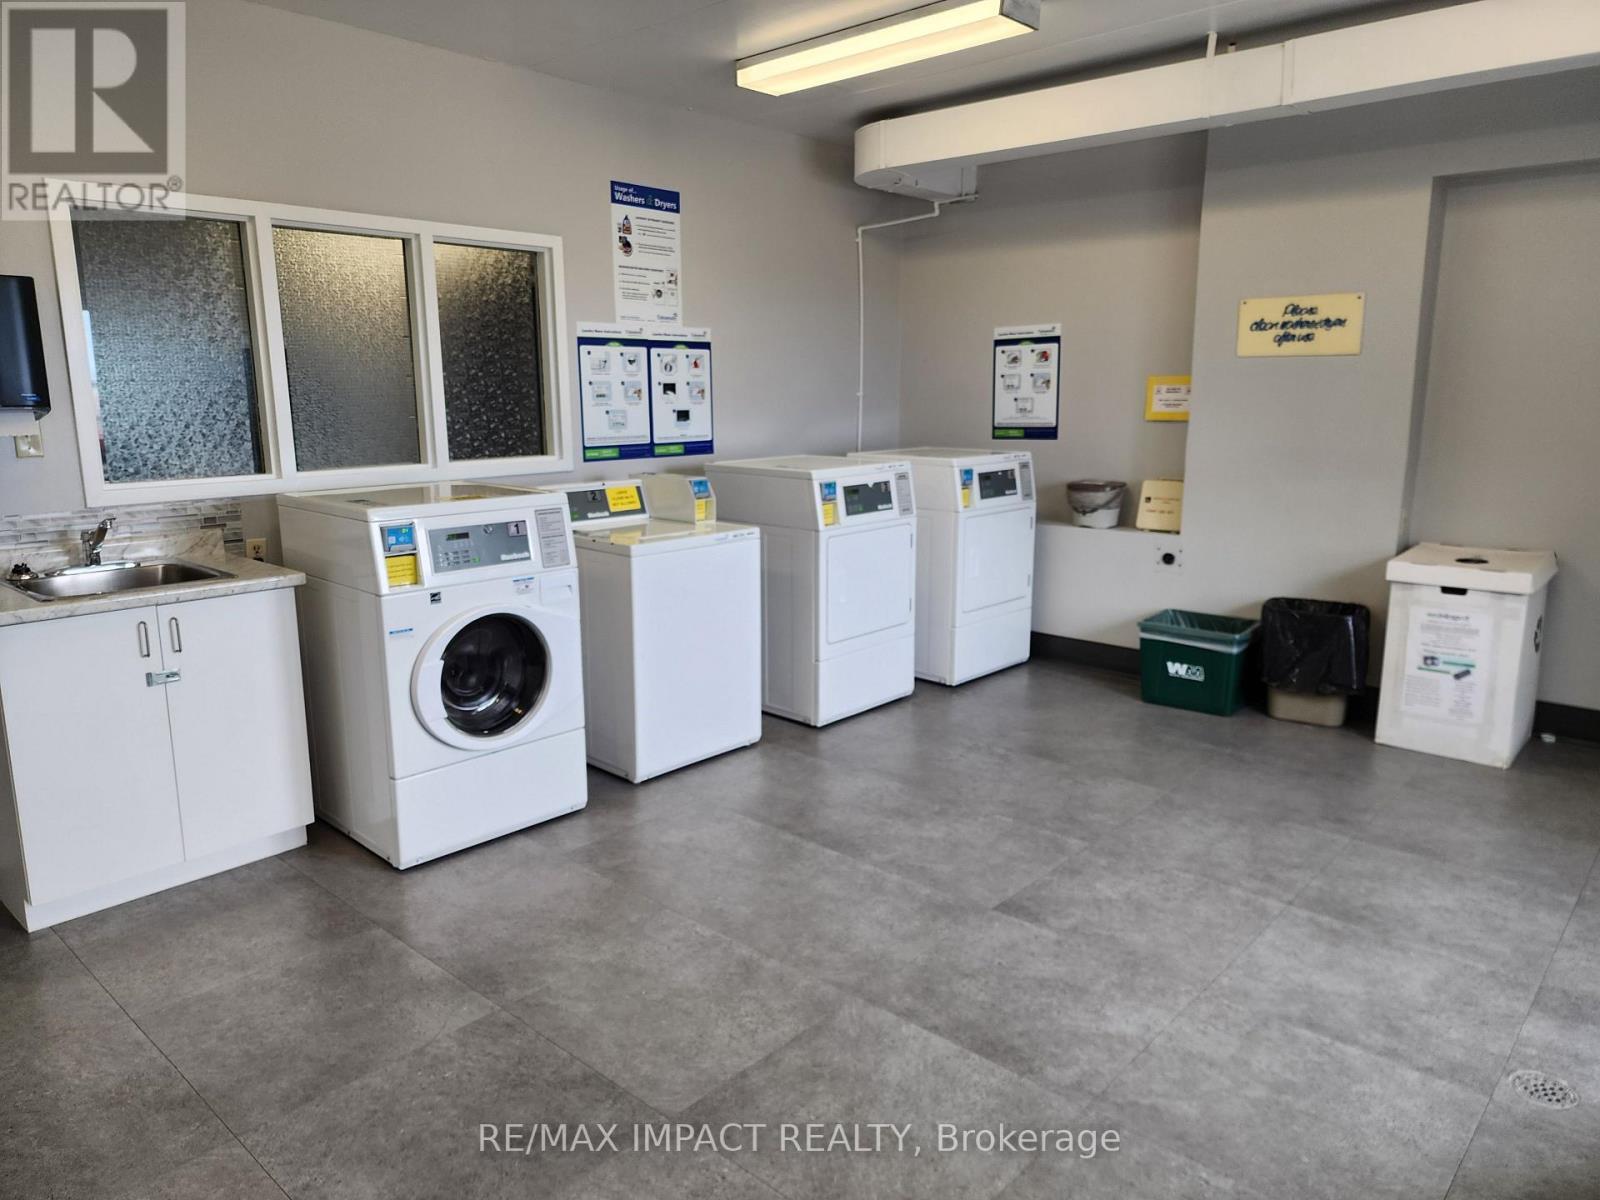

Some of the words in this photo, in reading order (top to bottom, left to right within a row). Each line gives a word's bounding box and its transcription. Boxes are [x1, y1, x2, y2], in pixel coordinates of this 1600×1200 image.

[614, 191, 645, 205] Washers
[654, 198, 677, 210] Dryers
[514, 523, 520, 534] 1
